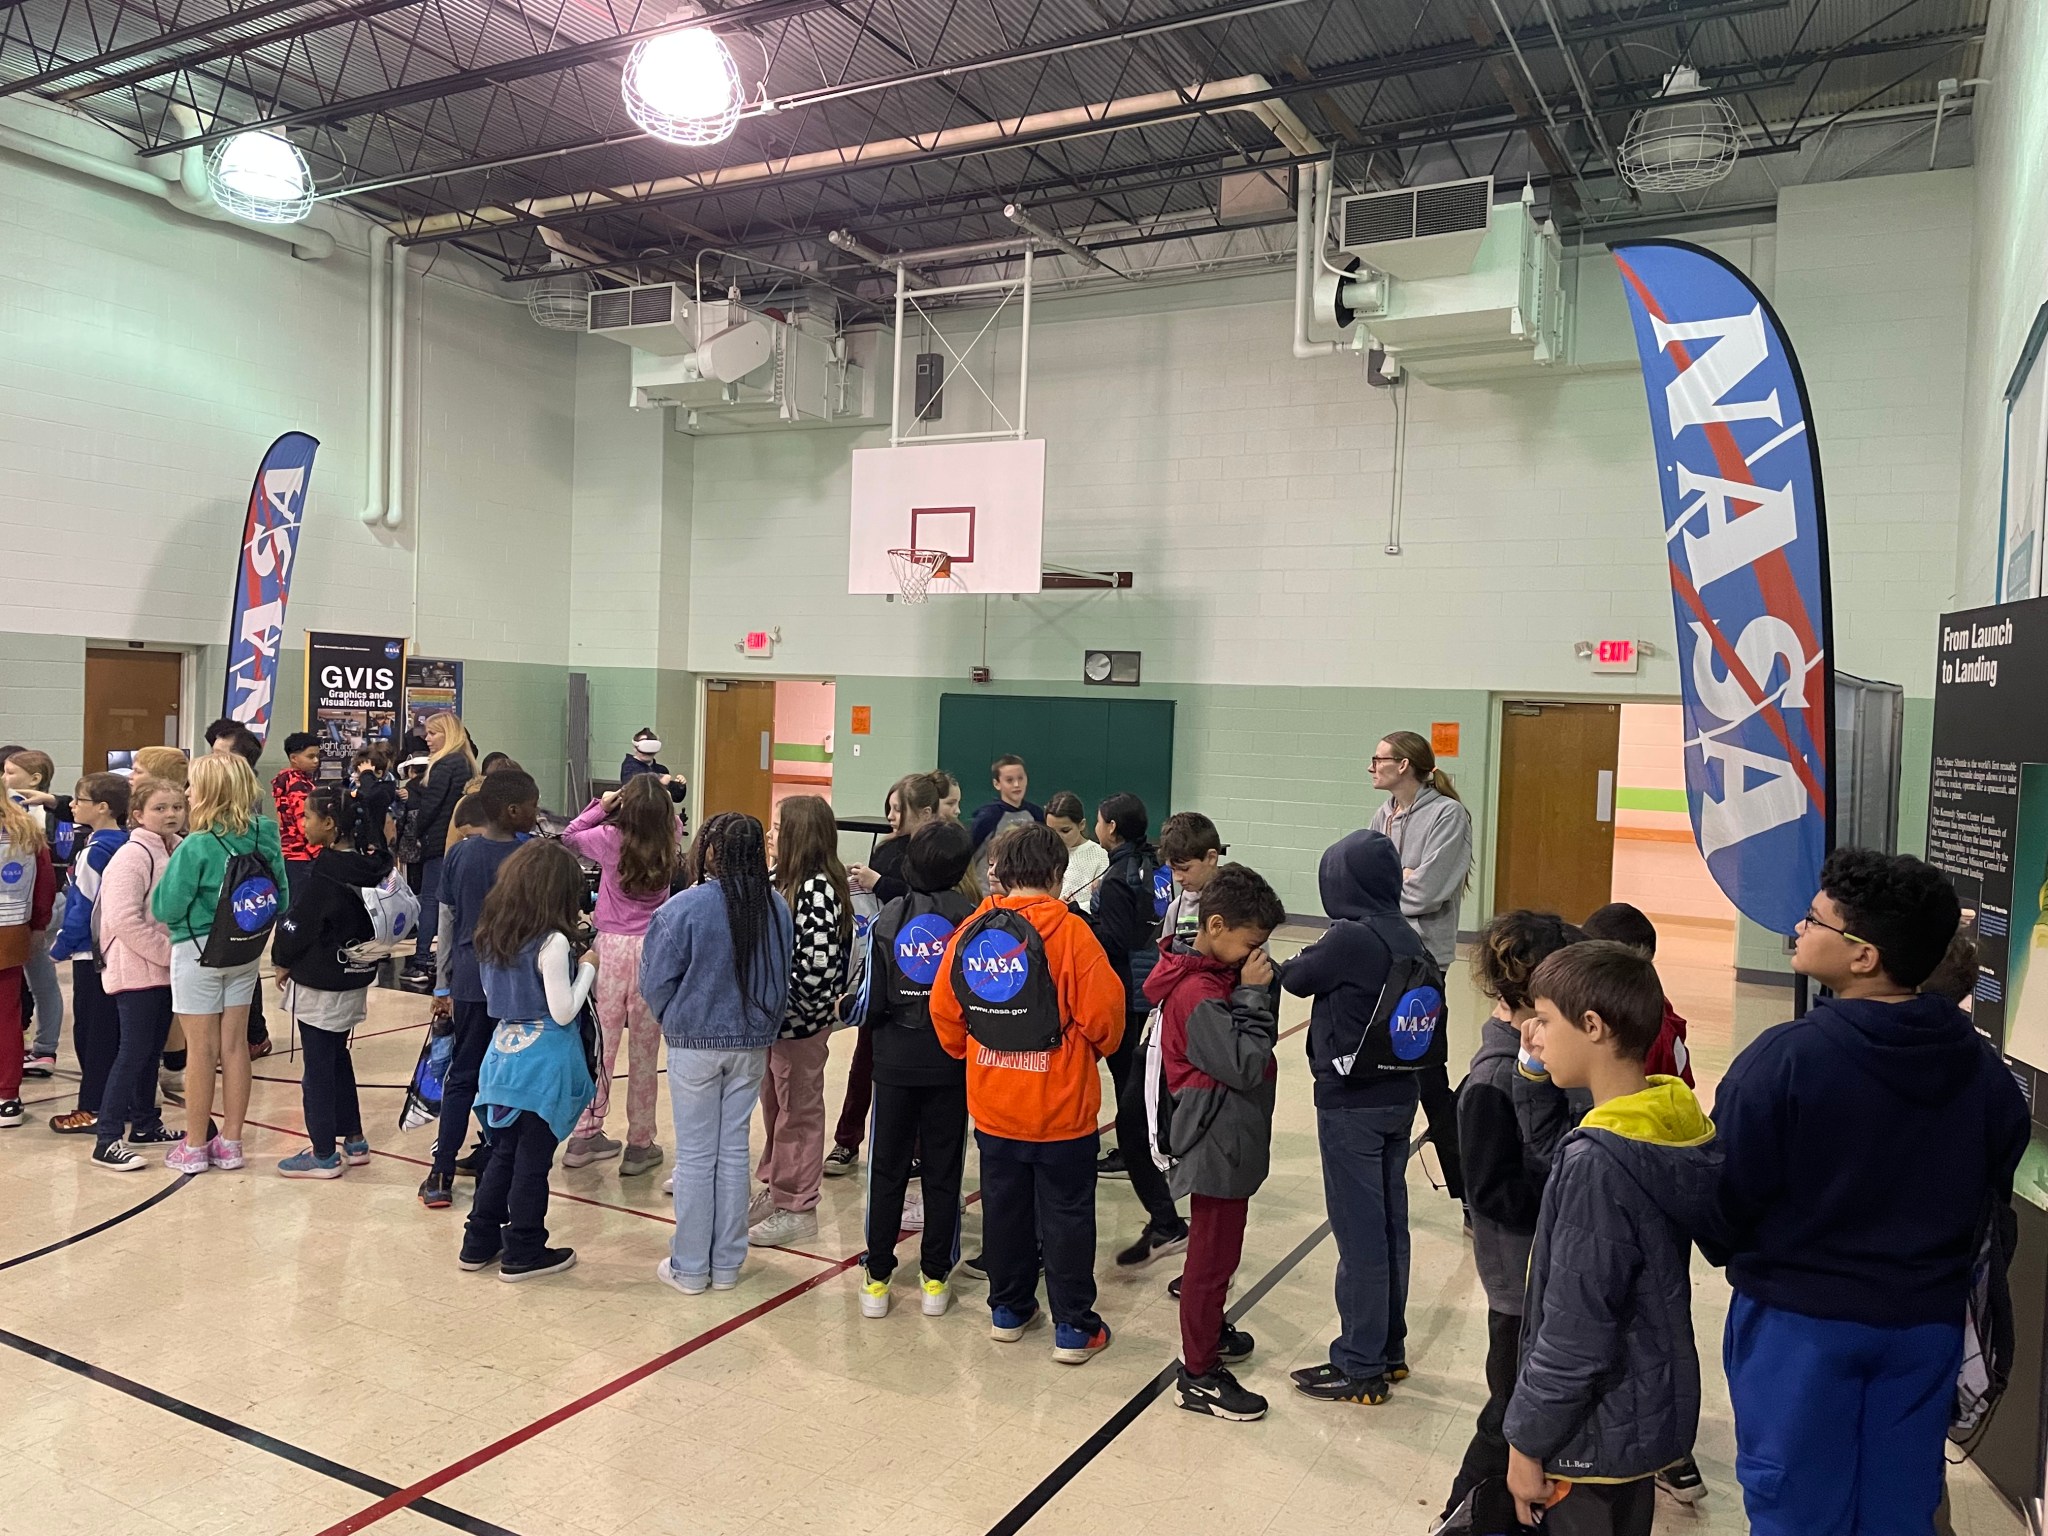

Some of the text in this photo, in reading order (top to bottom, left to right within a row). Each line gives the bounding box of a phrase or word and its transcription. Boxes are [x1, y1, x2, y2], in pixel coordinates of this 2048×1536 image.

[1649, 302, 1811, 860] NASA
[231, 466, 304, 739] NASA
[748, 632, 766, 649] EXIT
[1944, 618, 2012, 652] From Launch
[1599, 640, 1630, 662] EXIT
[321, 666, 394, 690] GVIS
[1942, 655, 1997, 688] to Landing
[321, 698, 393, 708] Visualization Lab
[329, 690, 366, 700] Graphics
[233, 893, 277, 914] NASA
[900, 941, 944, 957] NAS
[968, 958, 1024, 973] NASA
[969, 1005, 1027, 1015] www.nasa.gov
[1396, 1016, 1436, 1031] NASA
